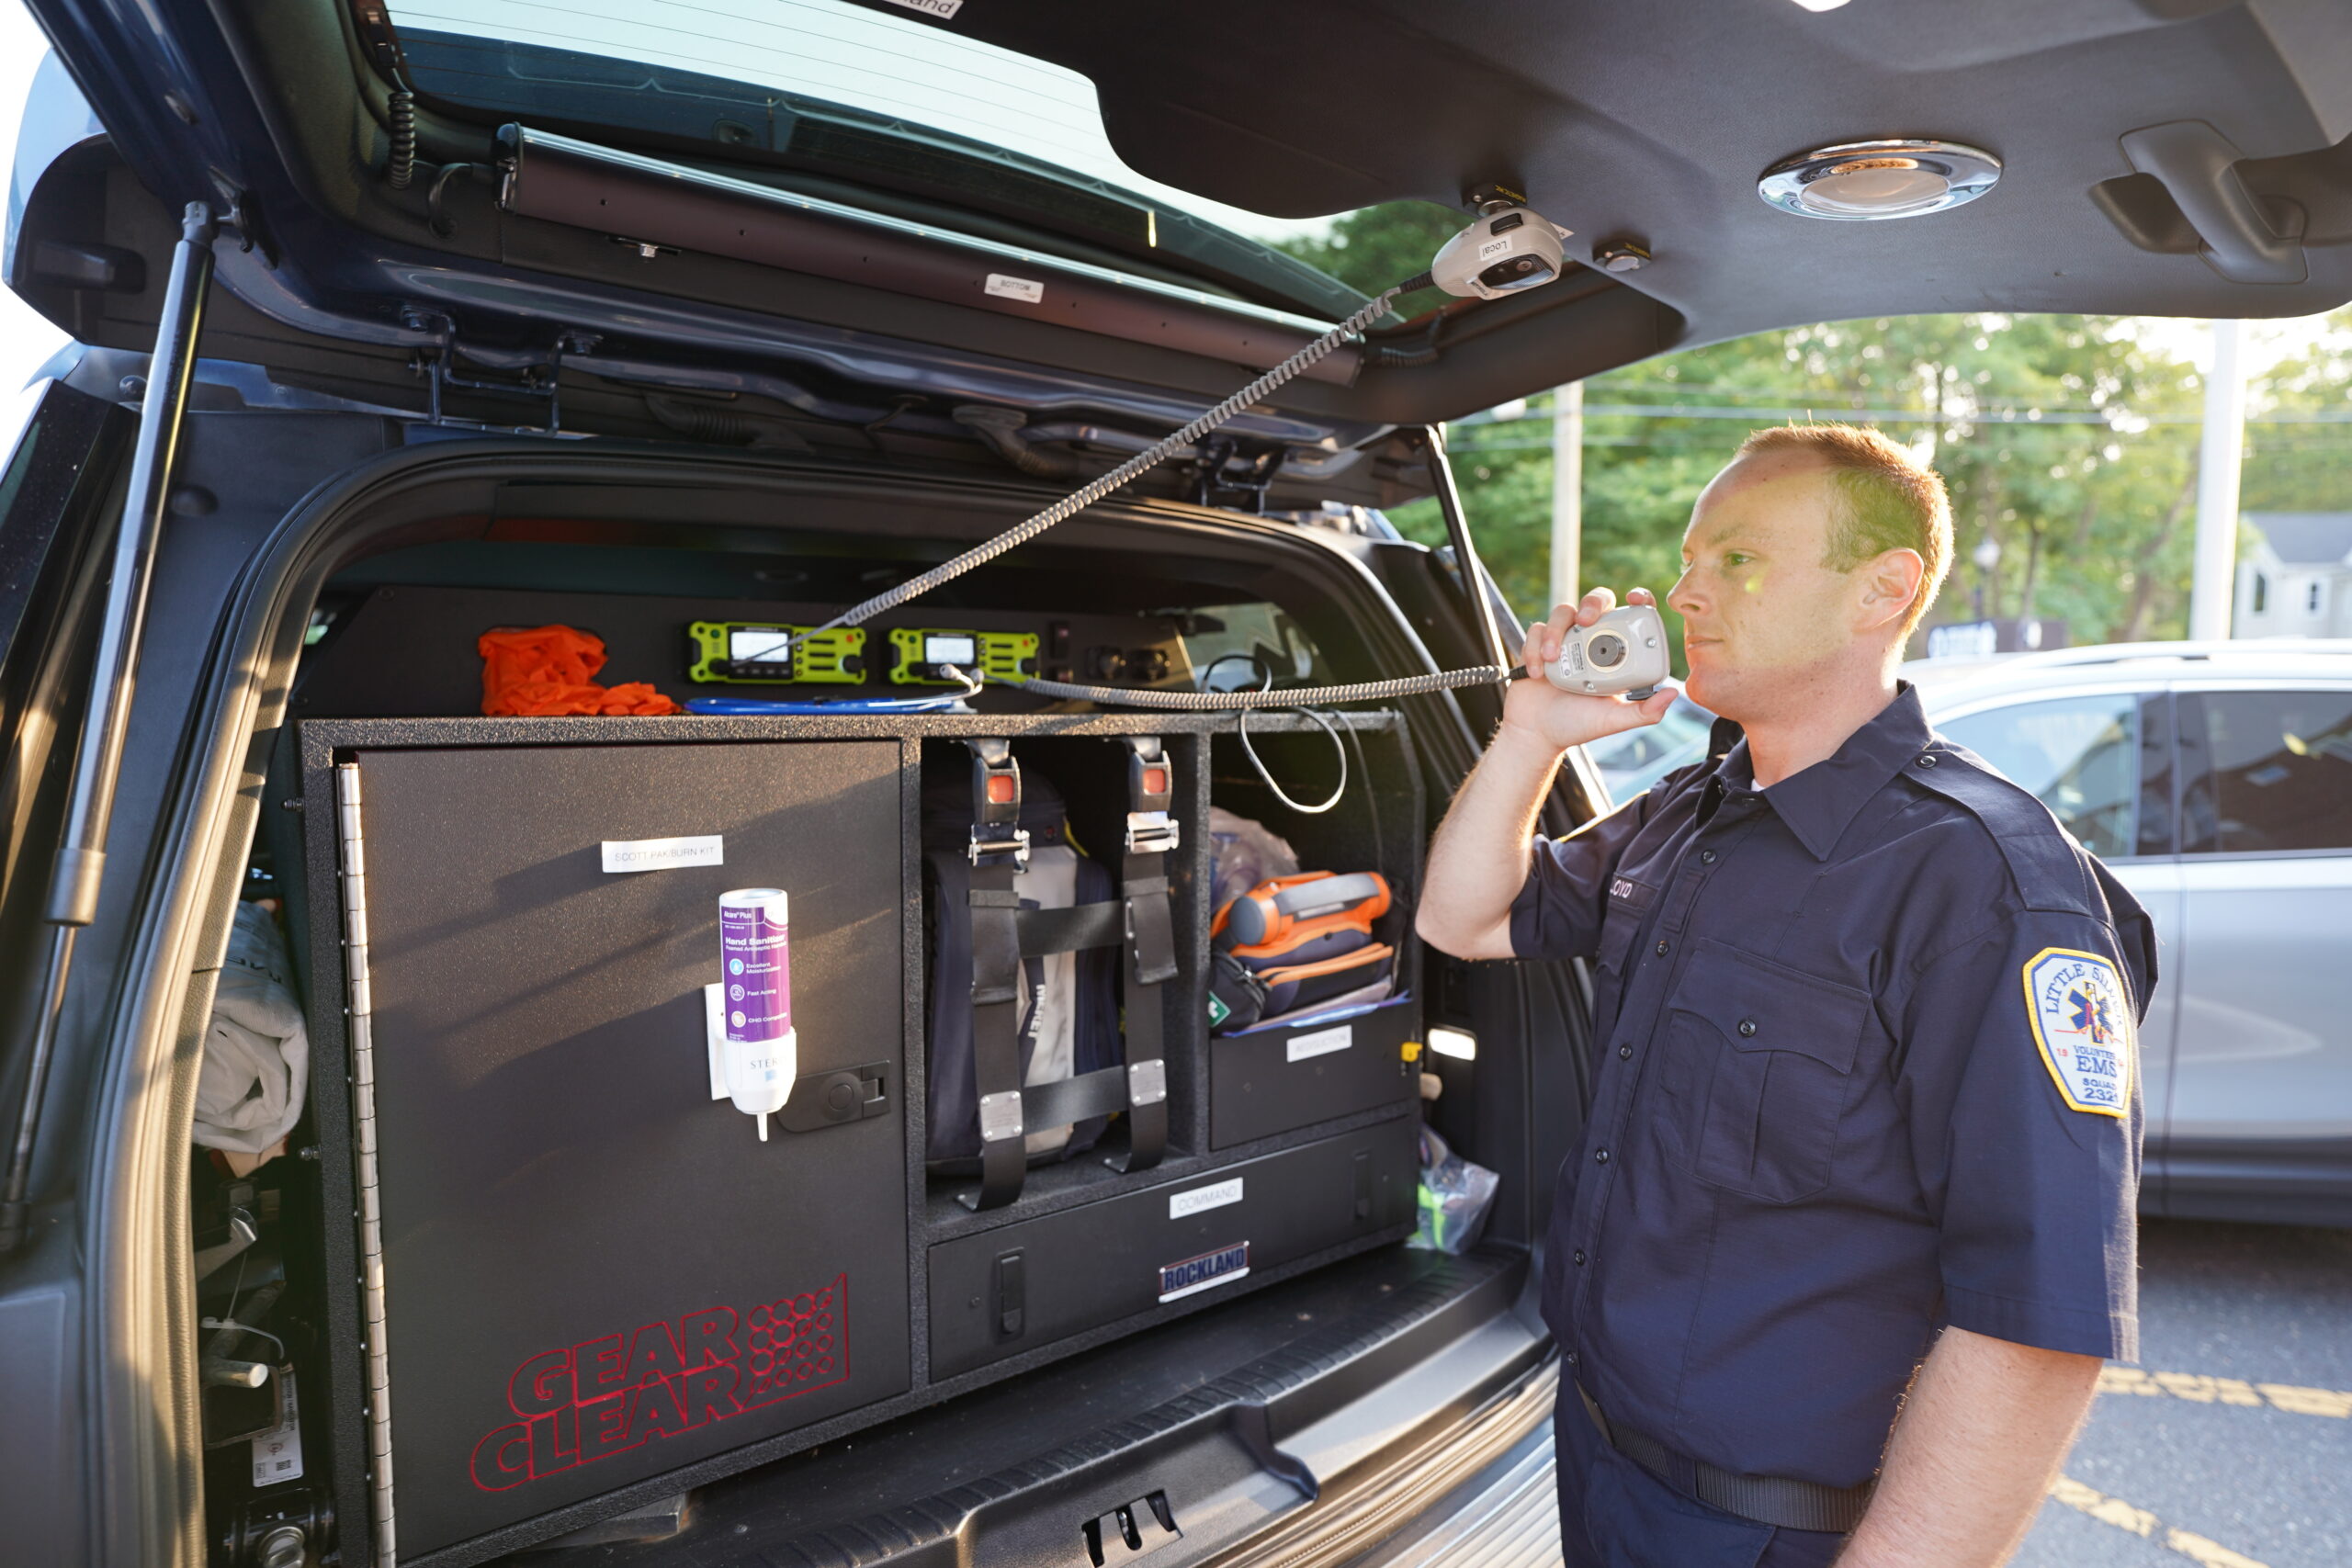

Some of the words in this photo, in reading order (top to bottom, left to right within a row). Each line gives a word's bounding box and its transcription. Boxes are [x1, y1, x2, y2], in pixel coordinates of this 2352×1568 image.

[1481, 241, 1508, 257] Local
[615, 851, 647, 863] SCOTT
[725, 937, 747, 946] Hand
[2046, 963, 2086, 1015] LITTLE
[2075, 1055, 2117, 1078] EMS
[1178, 1185, 1238, 1212] COMMAND
[1164, 1247, 1245, 1291] ROCKLAND
[507, 1305, 741, 1418] GEAR
[470, 1363, 742, 1492] CLEAR
